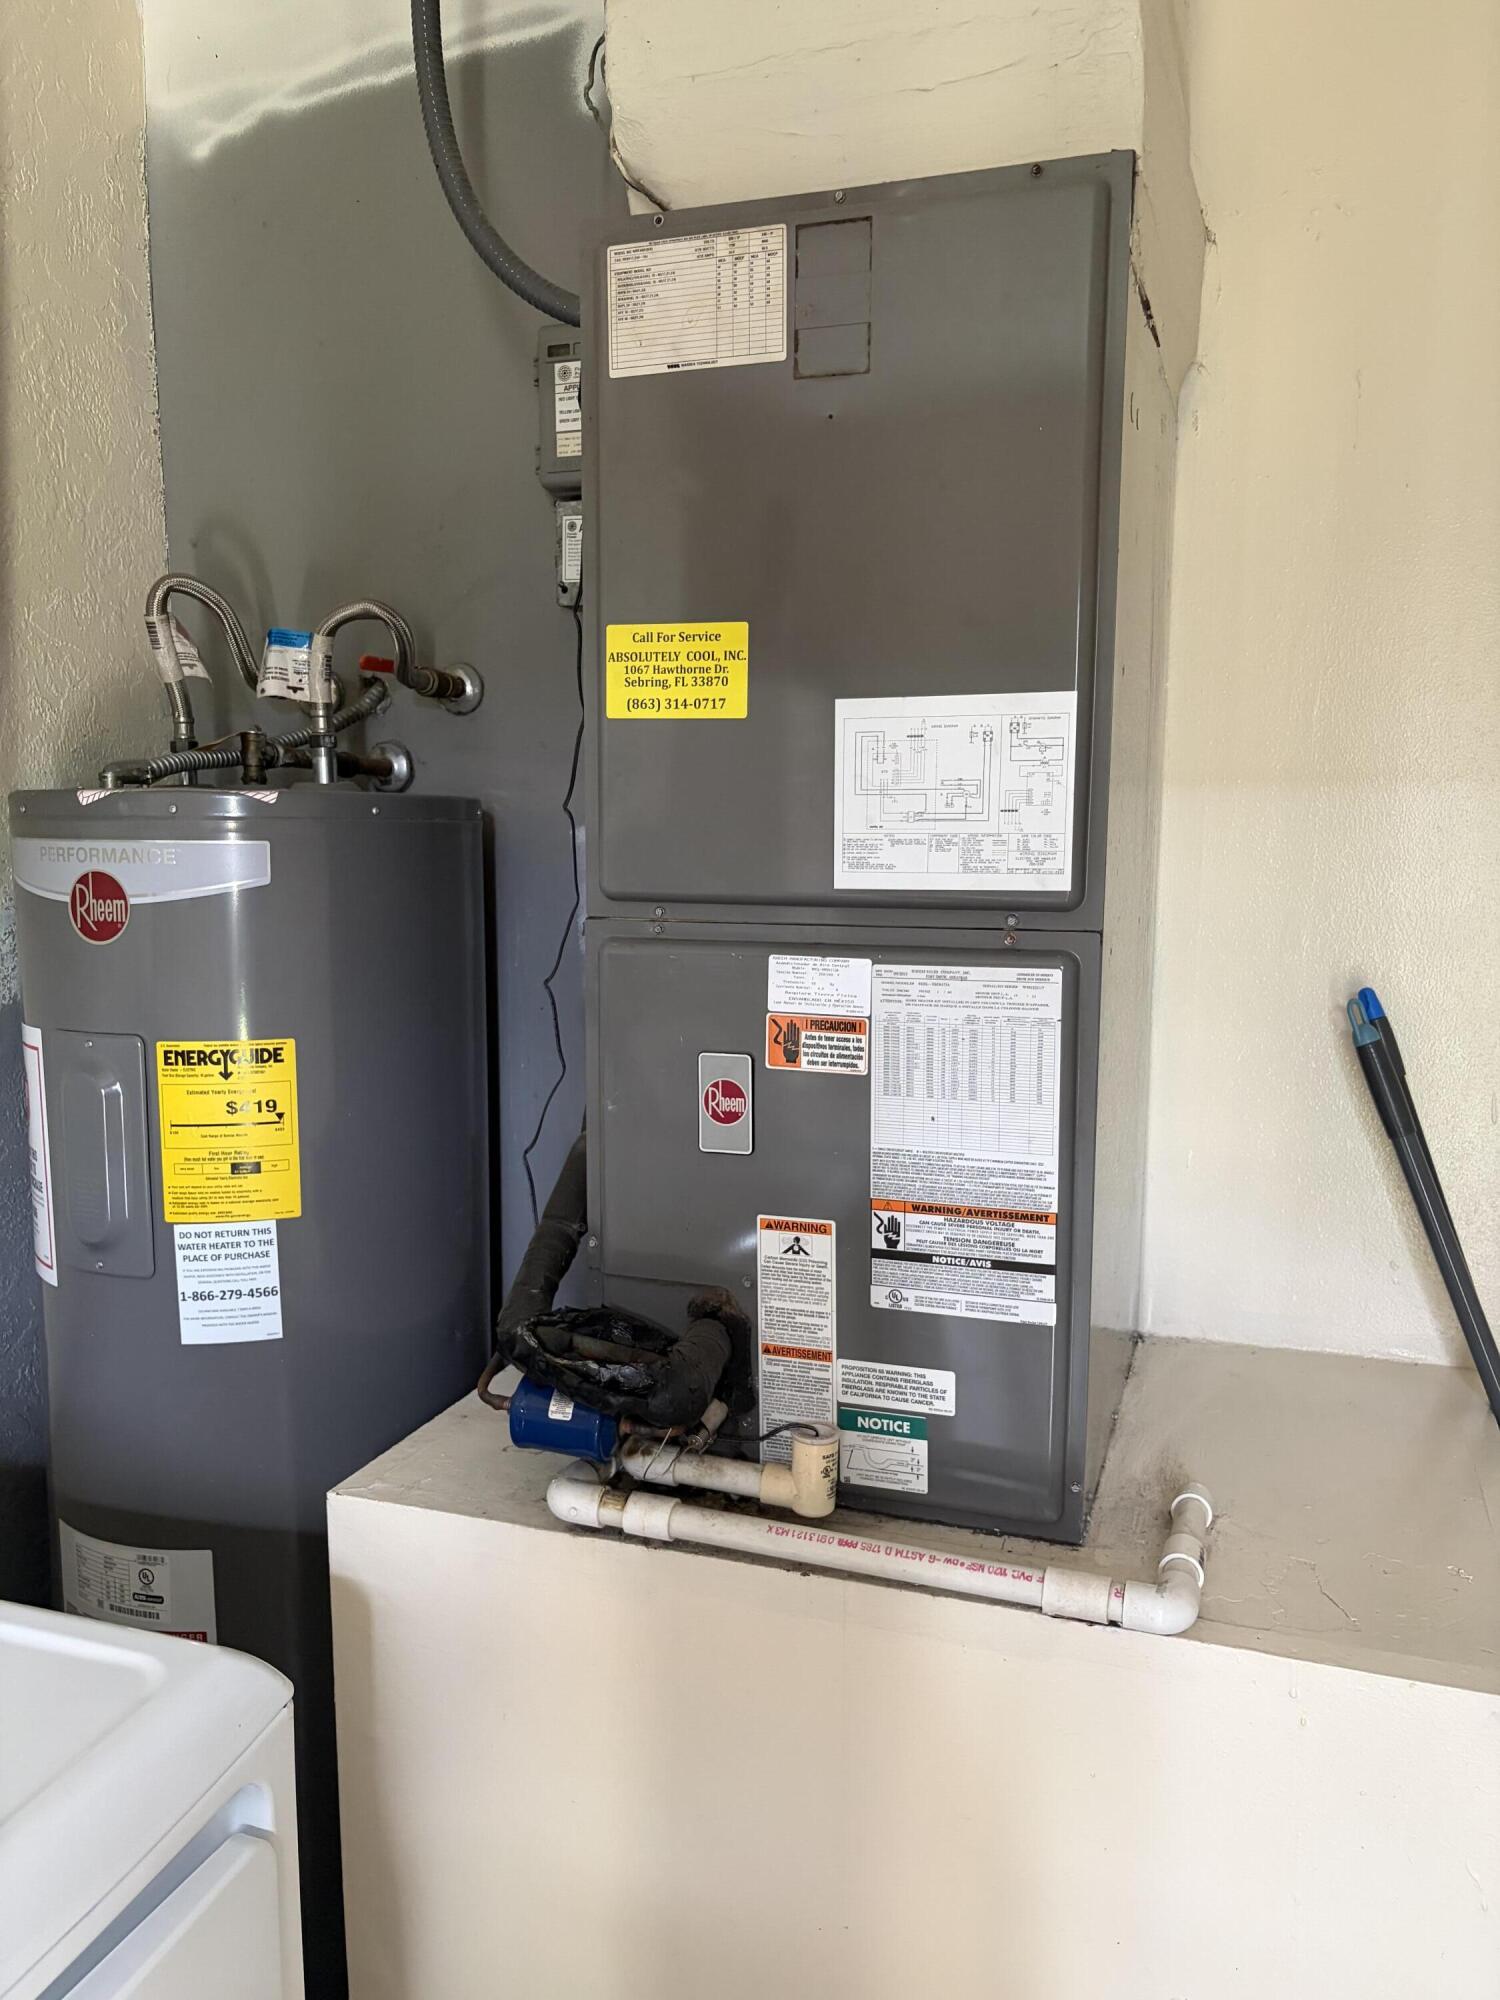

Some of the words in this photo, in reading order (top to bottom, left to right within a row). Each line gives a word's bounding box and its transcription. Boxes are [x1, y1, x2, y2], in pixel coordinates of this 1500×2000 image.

[632, 632, 653, 642] Call
[657, 632, 676, 642] For
[678, 631, 721, 642] Service
[608, 652, 680, 662] ABSOLUTELY
[687, 651, 720, 662] COOL,
[724, 650, 746, 661] INC.
[624, 665, 649, 674] 1067
[653, 664, 711, 674] Hawthorne
[715, 664, 729, 673] Dr.
[624, 677, 671, 689] Sebring,
[675, 677, 688, 686] FL
[691, 676, 728, 686] 33870
[627, 698, 661, 712] (863)
[665, 698, 726, 709] 314-0717
[39, 846, 176, 864] PERFORMANCE
[76, 872, 127, 931] Rheem
[810, 1021, 856, 1032] PRECAUCION
[802, 1042, 827, 1050] dispositivos
[828, 1043, 852, 1052] terminales,
[836, 1053, 863, 1061] alimentación
[829, 1060, 859, 1069] interrumpidos.
[709, 1080, 745, 1118] Rheem
[226, 1099, 277, 1115] $419
[911, 1204, 1050, 1223] WARNING/AVERTISSEMENT
[774, 1220, 826, 1234] WARNING
[944, 1217, 984, 1226] HAZARDOUS
[215, 1229, 250, 1238] RETURN
[178, 1243, 207, 1251] WATER
[209, 1241, 241, 1250] HEATER
[943, 1236, 971, 1245] TENSION
[973, 1238, 1015, 1248] DANGEREUSE
[183, 1254, 208, 1262] PLACE
[224, 1250, 270, 1260] PURCHASE
[932, 1256, 992, 1268] NOTICE/AVIS
[180, 1286, 278, 1301] 1-866-279-4566
[772, 1346, 832, 1360] AVERTISSEMENT
[842, 1364, 877, 1372] PROPOSITION
[842, 1384, 874, 1392] FIBERGLASS
[875, 1382, 908, 1390] RESPIRABLE
[900, 1378, 933, 1386] FIBERGLASS
[857, 1416, 911, 1433] NOTICE
[860, 1542, 881, 1553] 1785
[885, 1546, 892, 1556] D
[895, 1548, 926, 1562] ASTM
[965, 1562, 985, 1573] NSF
[1011, 1570, 1032, 1582] PVC
